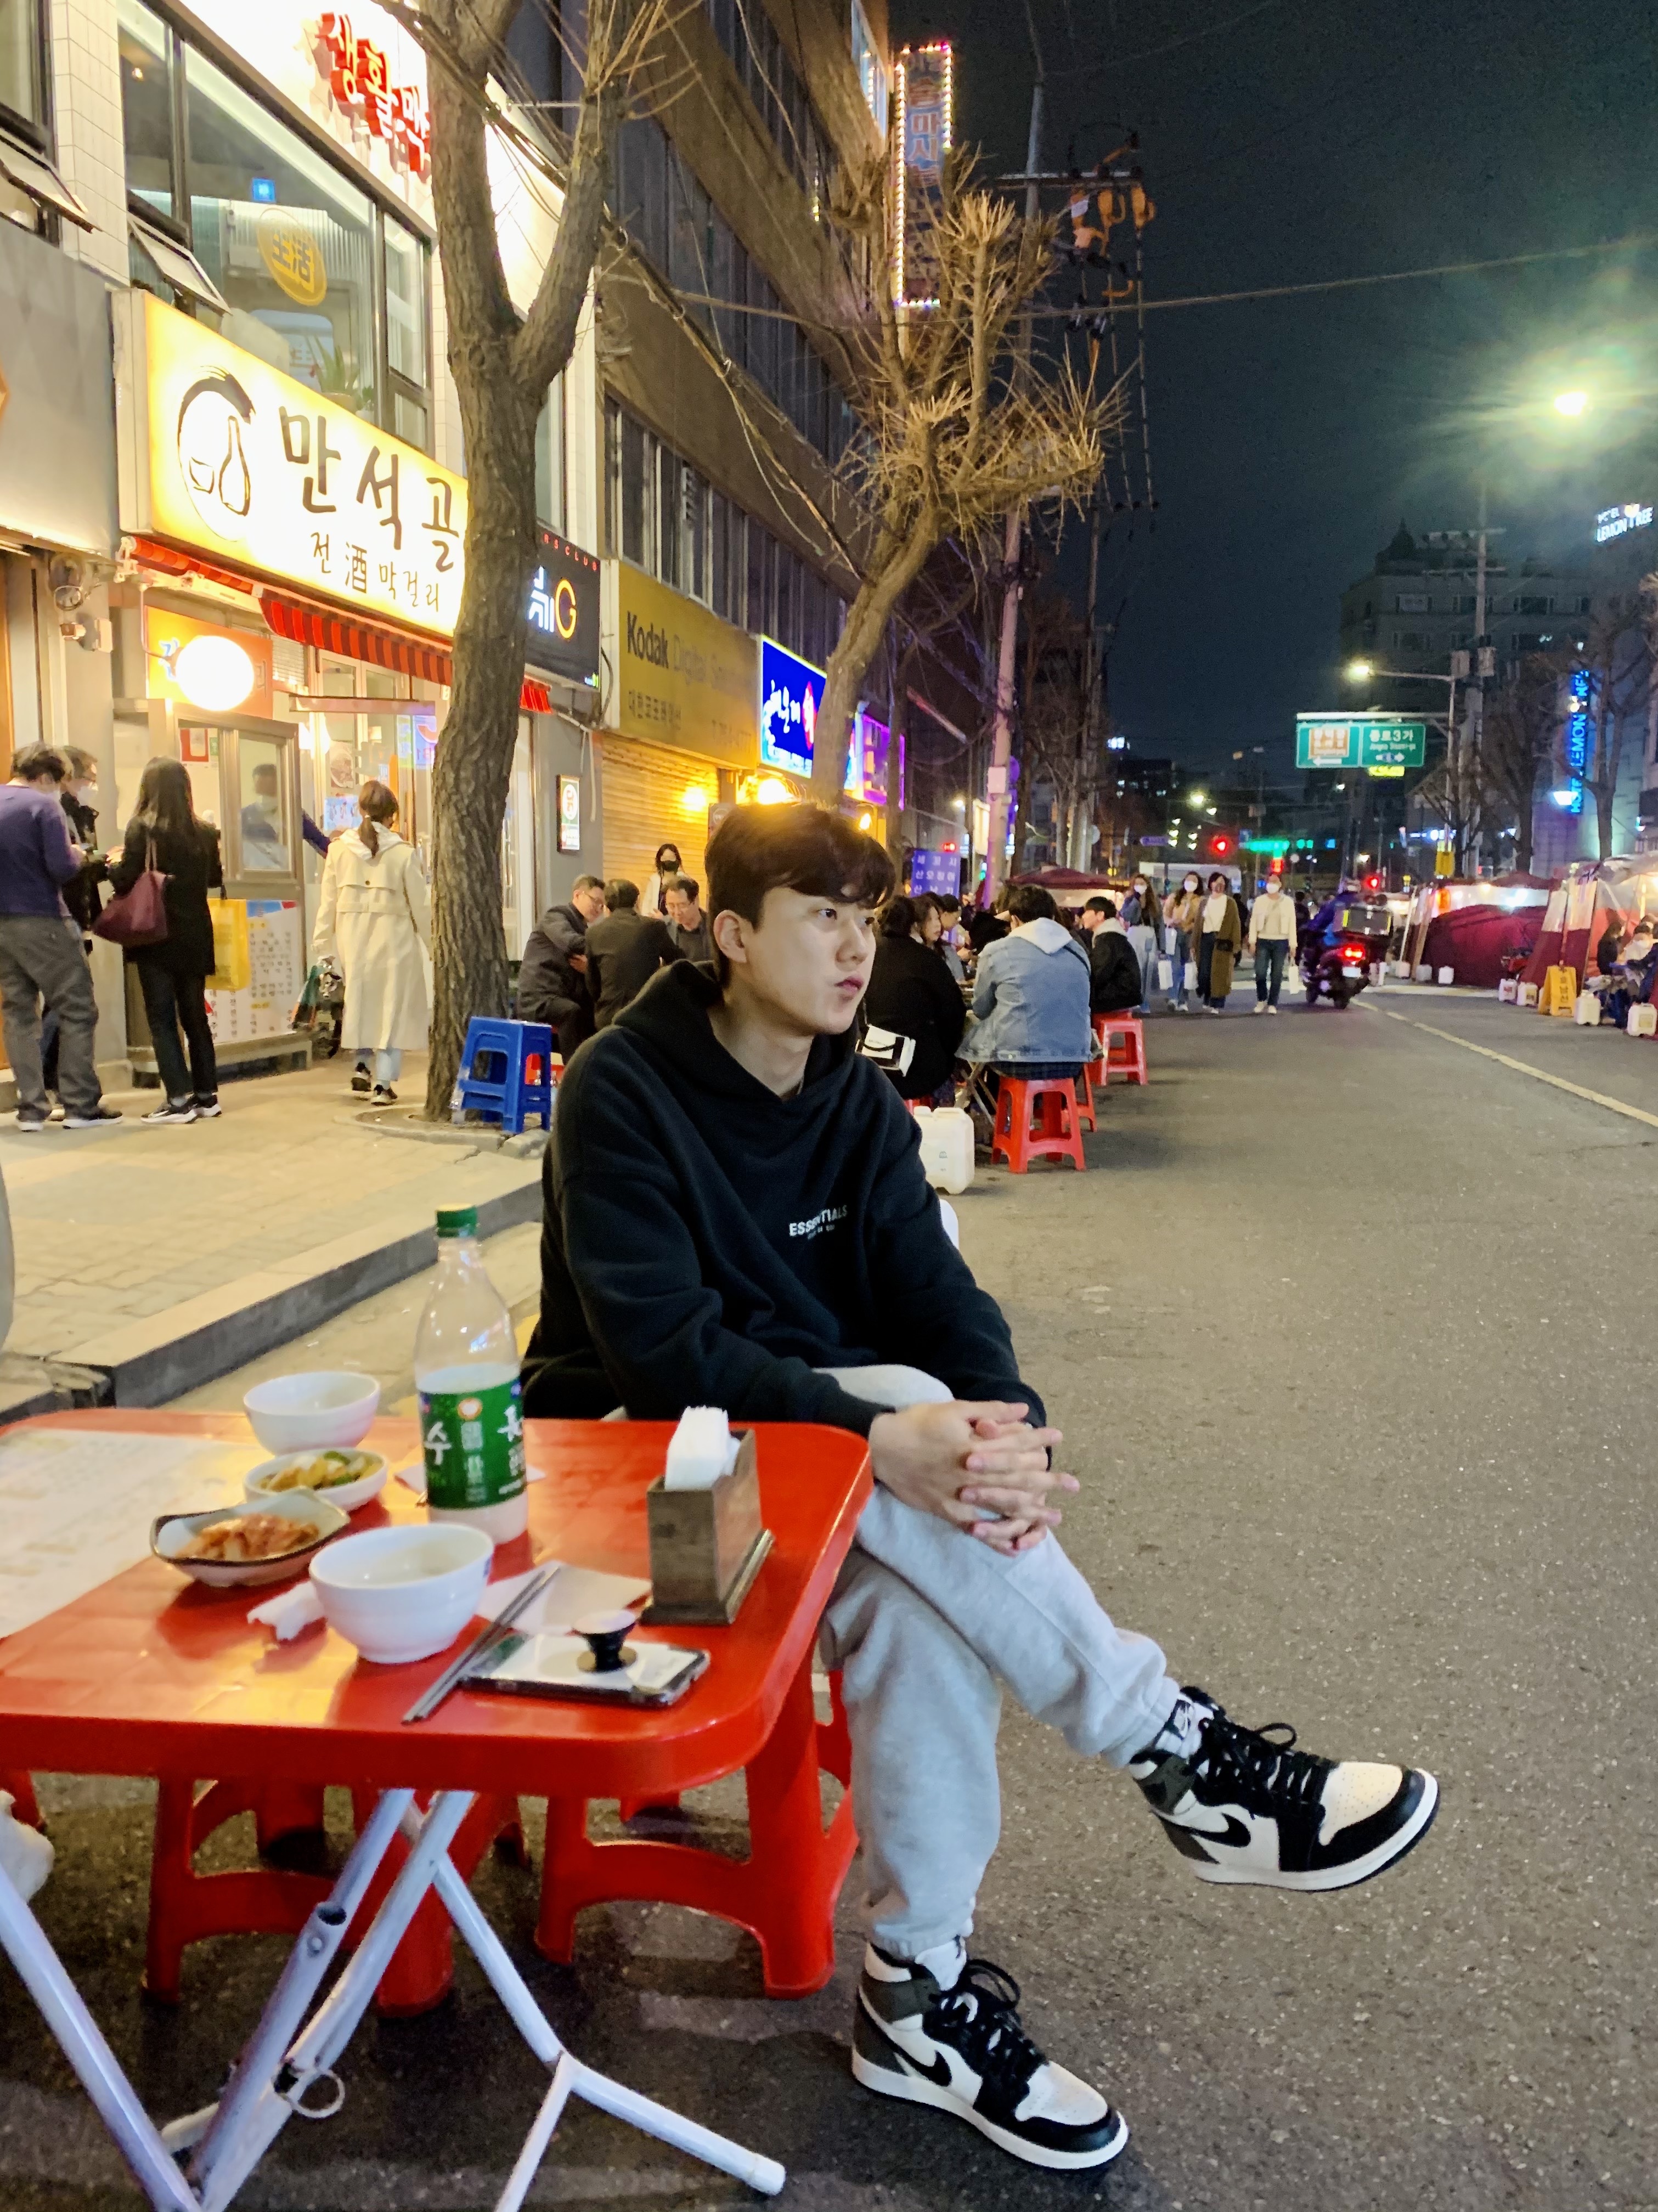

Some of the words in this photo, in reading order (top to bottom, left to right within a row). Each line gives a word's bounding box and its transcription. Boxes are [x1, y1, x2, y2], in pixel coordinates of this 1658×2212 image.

[278, 405, 460, 573] 만석골
[311, 532, 331, 574] 전
[345, 541, 367, 594] 酒
[379, 561, 439, 613] 막걸리
[627, 610, 669, 669] Kodak
[1571, 714, 1587, 767] LEMON
